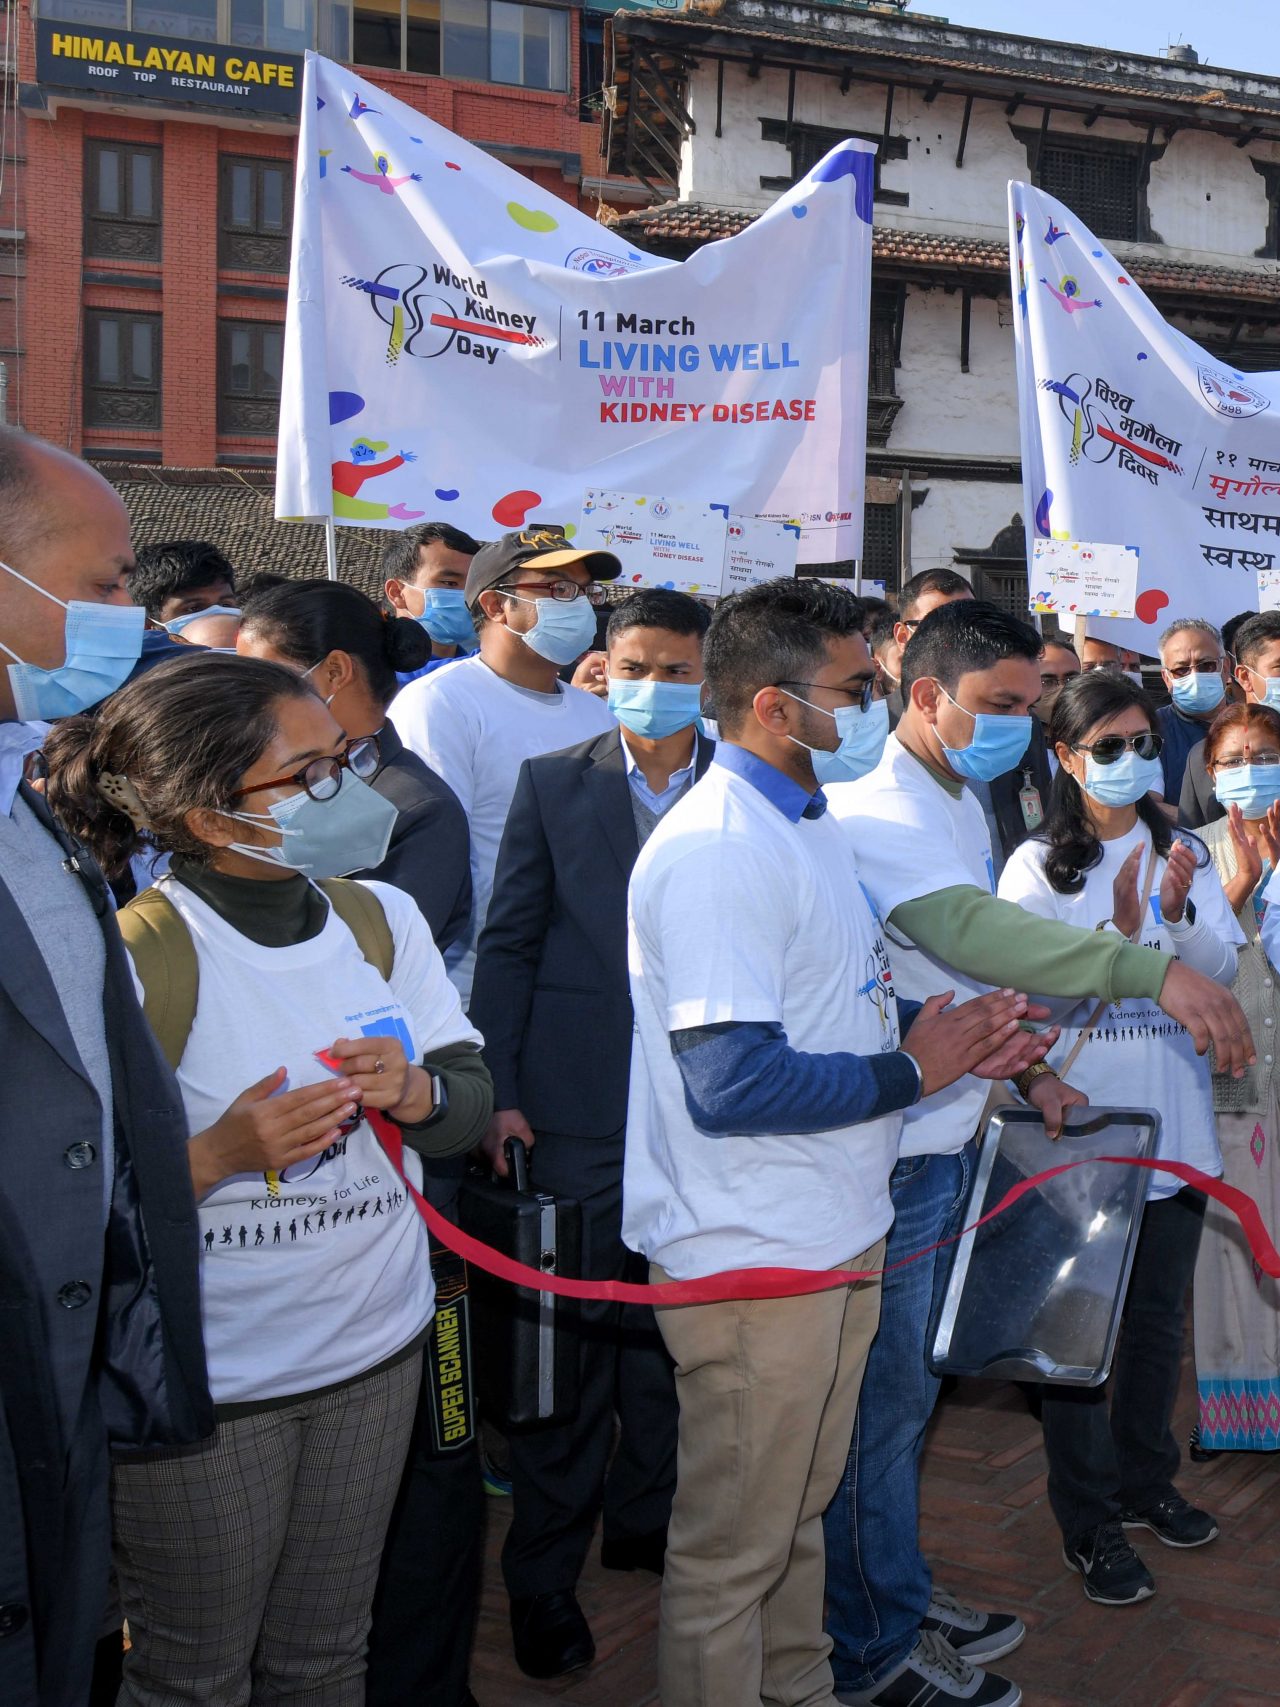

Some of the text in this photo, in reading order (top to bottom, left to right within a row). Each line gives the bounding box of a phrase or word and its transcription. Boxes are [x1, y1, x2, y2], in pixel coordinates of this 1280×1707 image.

[52, 33, 295, 88] HIMALAYAN CAFE
[88, 65, 251, 97] ROOF TOP RESTAURANT
[433, 264, 488, 299] World
[464, 297, 537, 334] Kidney
[577, 310, 695, 335] 11 March
[457, 335, 499, 365] Day
[579, 340, 800, 372] LIVING WELL
[599, 374, 674, 398] WITH
[1095, 377, 1135, 414] विश्व
[600, 399, 817, 424] KIDNEY DISEASE
[1217, 401, 1243, 415] 1998
[1120, 414, 1183, 457] मृगौला
[1118, 448, 1160, 486] दिवस
[1216, 449, 1236, 467] ११
[650, 539, 700, 550] LIVING WELL
[678, 554, 704, 562] DISEASE
[1200, 543, 1276, 571] स्वस्थ
[1108, 1009, 1160, 1020] Kidneys for
[251, 1173, 380, 1210] Kidneys for Life
[435, 1306, 462, 1384] SCANNER
[441, 1383, 466, 1442] SUPER
